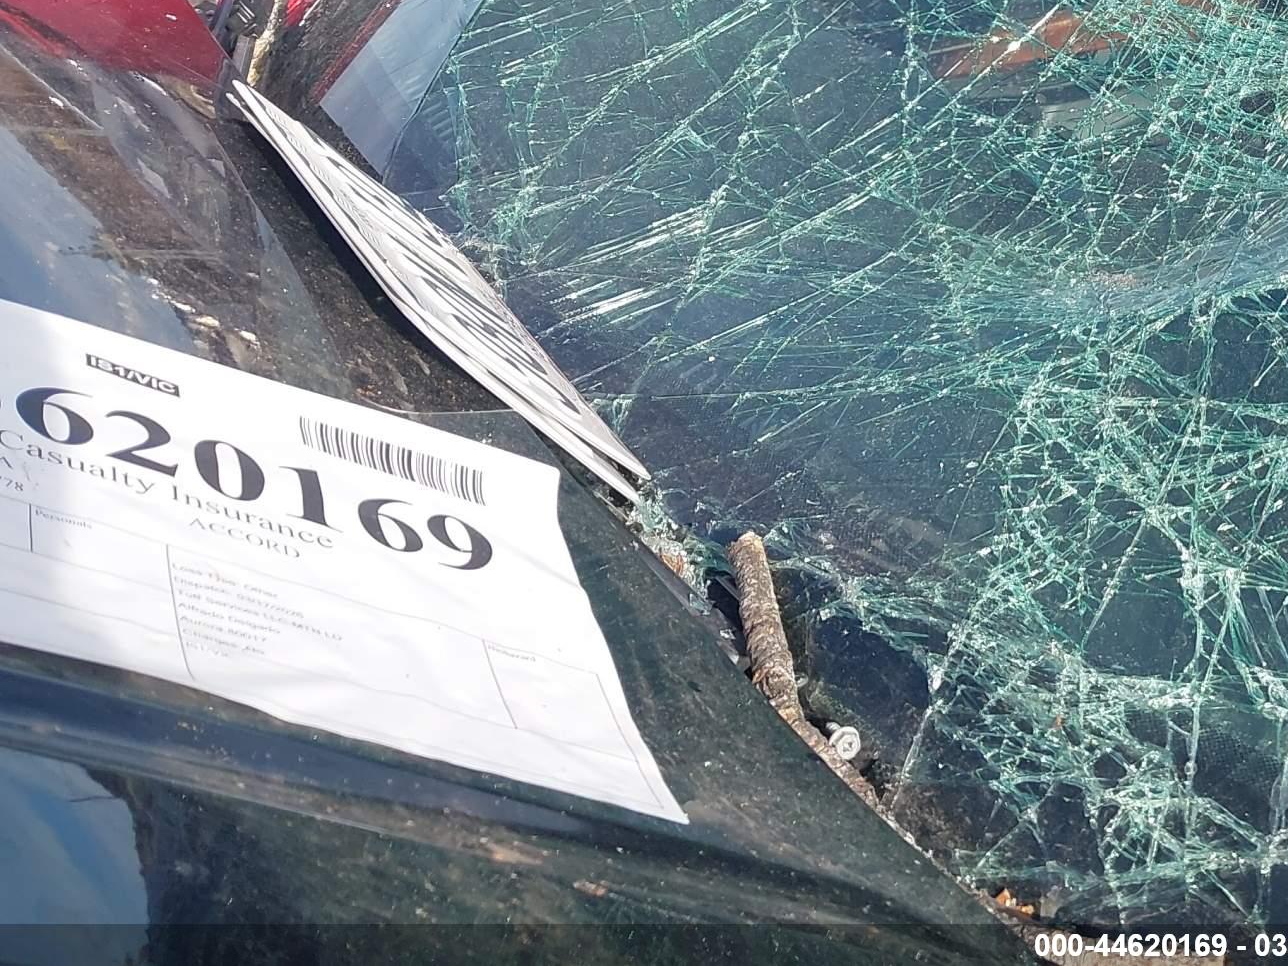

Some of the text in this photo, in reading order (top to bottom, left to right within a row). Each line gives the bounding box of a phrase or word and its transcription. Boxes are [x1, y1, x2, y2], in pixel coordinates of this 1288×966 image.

[0, 386, 492, 570] 620169
[0, 475, 24, 491] 78
[0, 429, 333, 548] Casualty Insurance
[188, 518, 300, 559] ACCORD
